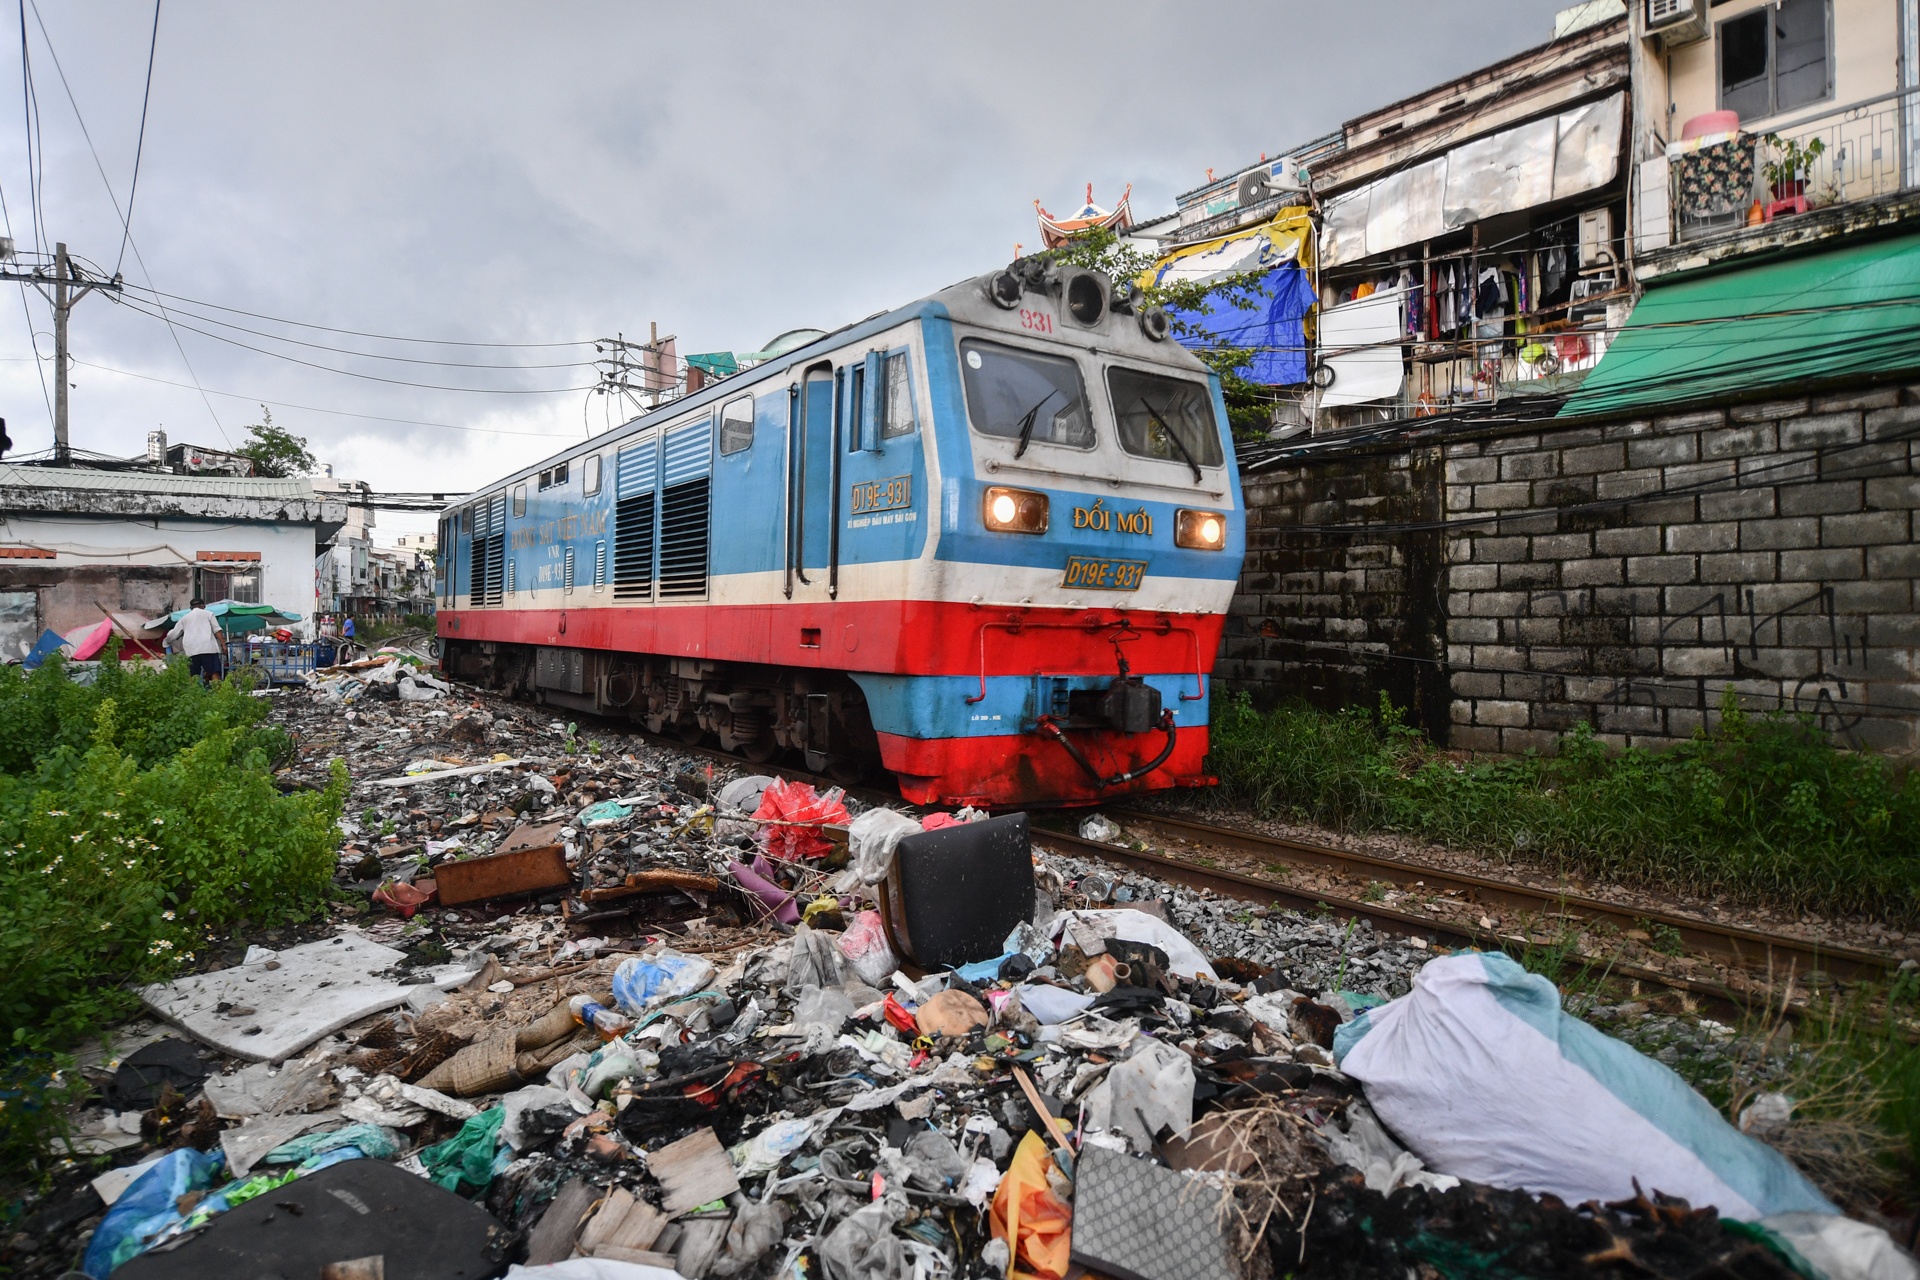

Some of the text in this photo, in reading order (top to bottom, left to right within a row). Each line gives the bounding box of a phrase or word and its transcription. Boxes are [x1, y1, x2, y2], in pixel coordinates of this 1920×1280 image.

[1020, 309, 1052, 334] 931
[853, 480, 908, 510] D19E-931
[1073, 498, 1153, 535] ĐỔI MỚI
[1067, 561, 1144, 587] D19E-931
